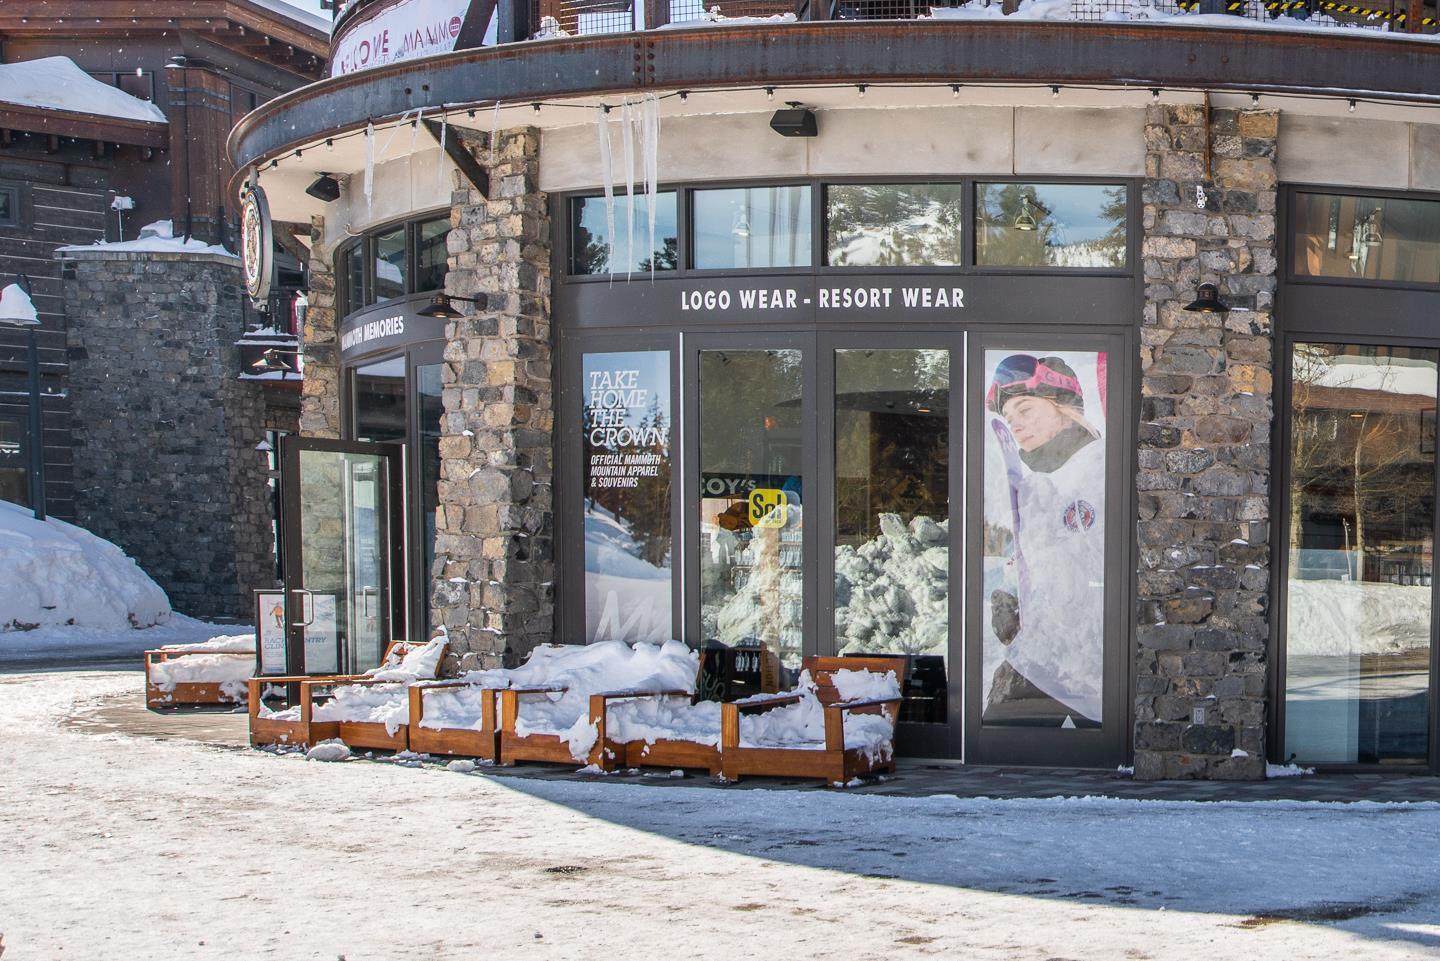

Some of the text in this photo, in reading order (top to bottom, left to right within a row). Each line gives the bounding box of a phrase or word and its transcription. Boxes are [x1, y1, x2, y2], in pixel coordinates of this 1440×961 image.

[681, 290, 731, 310] LOGO
[739, 289, 798, 309] WEAR
[819, 288, 893, 308] RESORT
[902, 287, 965, 307] WEAR
[364, 315, 404, 341] MEMORIES
[590, 370, 640, 390] TAKE
[589, 389, 648, 409] HOME
[590, 408, 627, 428] THE
[590, 427, 669, 447] CROWN
[590, 454, 662, 465] OFFICIAL MAMMOTH
[590, 465, 659, 476] MOUNTAIN APPAREL
[590, 477, 639, 488] & SOUVENIRS
